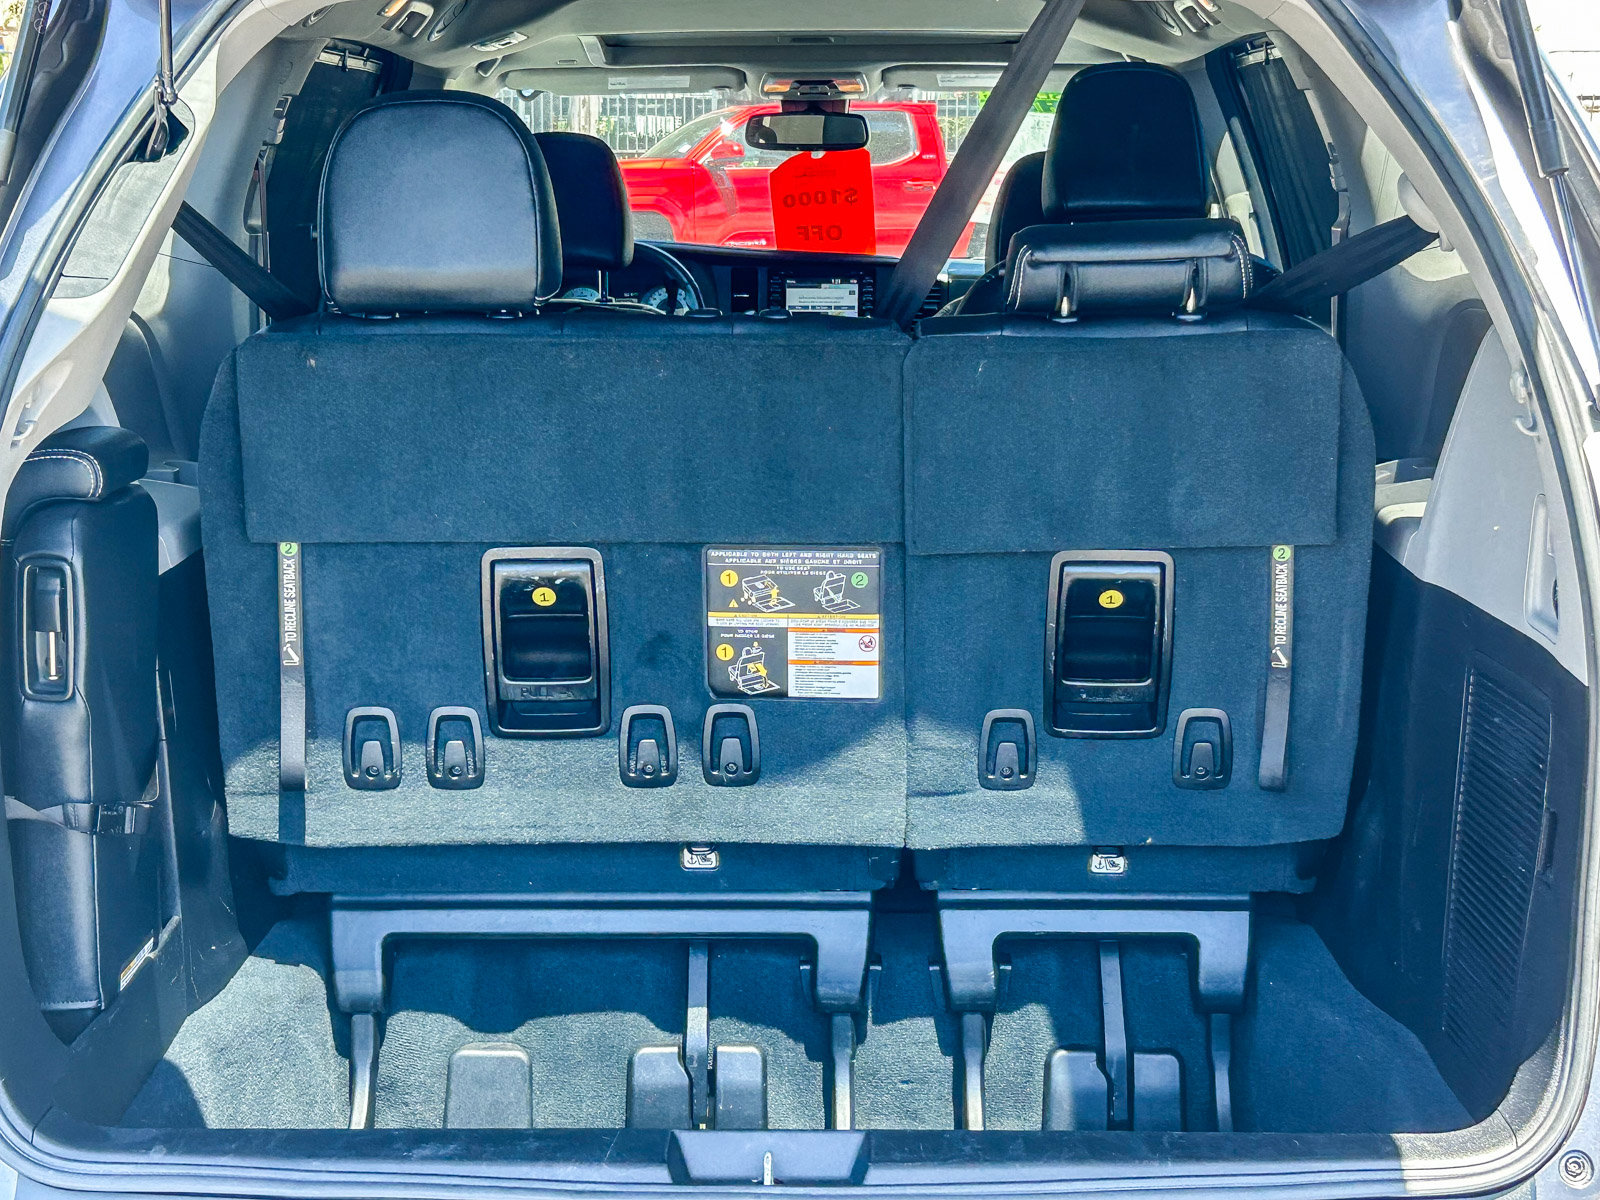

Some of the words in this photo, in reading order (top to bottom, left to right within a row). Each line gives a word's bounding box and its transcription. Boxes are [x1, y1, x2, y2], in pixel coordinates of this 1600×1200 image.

[284, 543, 292, 555] 2
[1278, 548, 1286, 559] 2
[283, 559, 296, 598] SEATBACK
[856, 574, 864, 586] 2
[1275, 564, 1288, 602] SEATBACK
[540, 592, 550, 602] 1
[1105, 595, 1116, 604] 1
[284, 599, 296, 632] RECLINE
[1274, 603, 1286, 634] RECLINE
[285, 632, 296, 642] TO
[1274, 635, 1286, 645] TO
